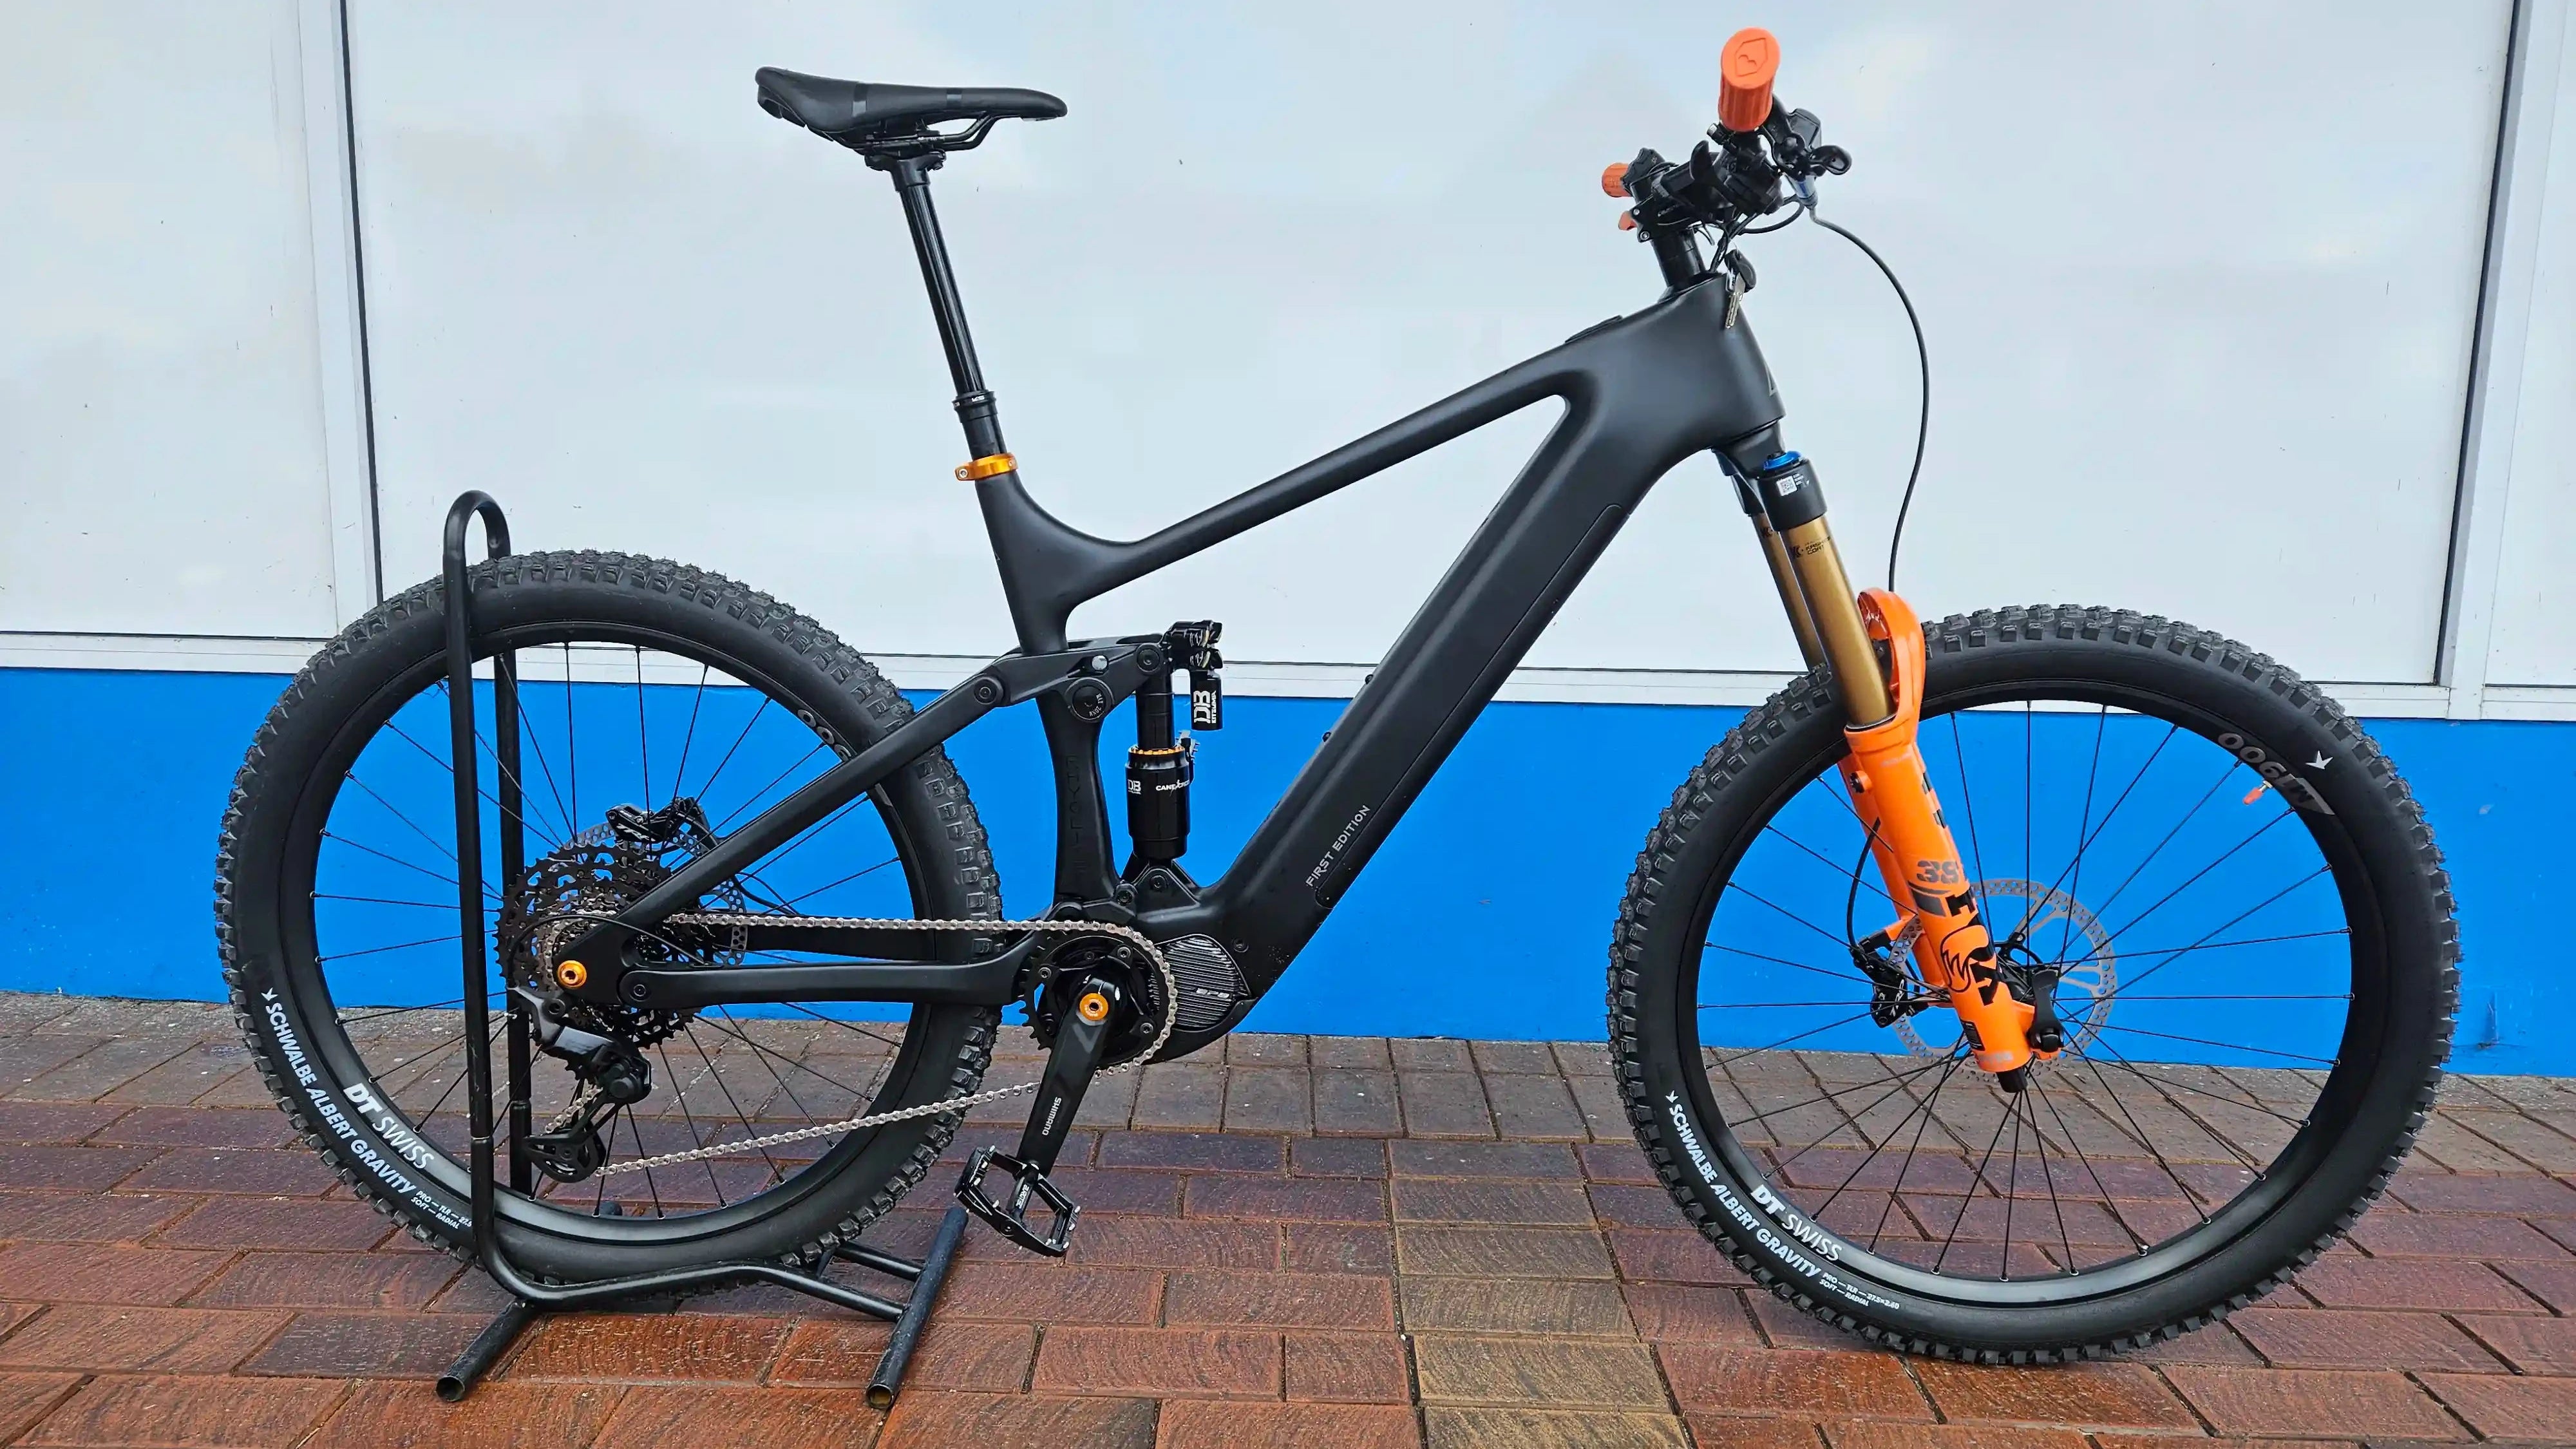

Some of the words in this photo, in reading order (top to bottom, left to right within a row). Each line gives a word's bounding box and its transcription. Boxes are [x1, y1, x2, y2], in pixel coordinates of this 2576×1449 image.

[1193, 690, 1211, 724] DB
[1305, 851, 1334, 887] FIRST
[1332, 804, 1370, 851] EDITION
[265, 1003, 317, 1087] SCHWALBE
[306, 1087, 358, 1139] ALBERT
[350, 1139, 417, 1193] GRAVITY
[343, 1083, 383, 1114] DT
[372, 1116, 435, 1169] SWISS
[1042, 1097, 1062, 1136] SHIMANO
[411, 1197, 430, 1210] SOFT
[436, 1212, 461, 1229] RADIAL
[1669, 1104, 1718, 1184] SCHWALBE
[1710, 1184, 1760, 1231] ALBERT
[1756, 1228, 1821, 1278] GRAVITY
[1750, 1184, 1786, 1215] DT
[1781, 1213, 1842, 1261] SWISS
[1819, 1279, 1837, 1292] SOFT
[1844, 1292, 1870, 1307] RADIAL
